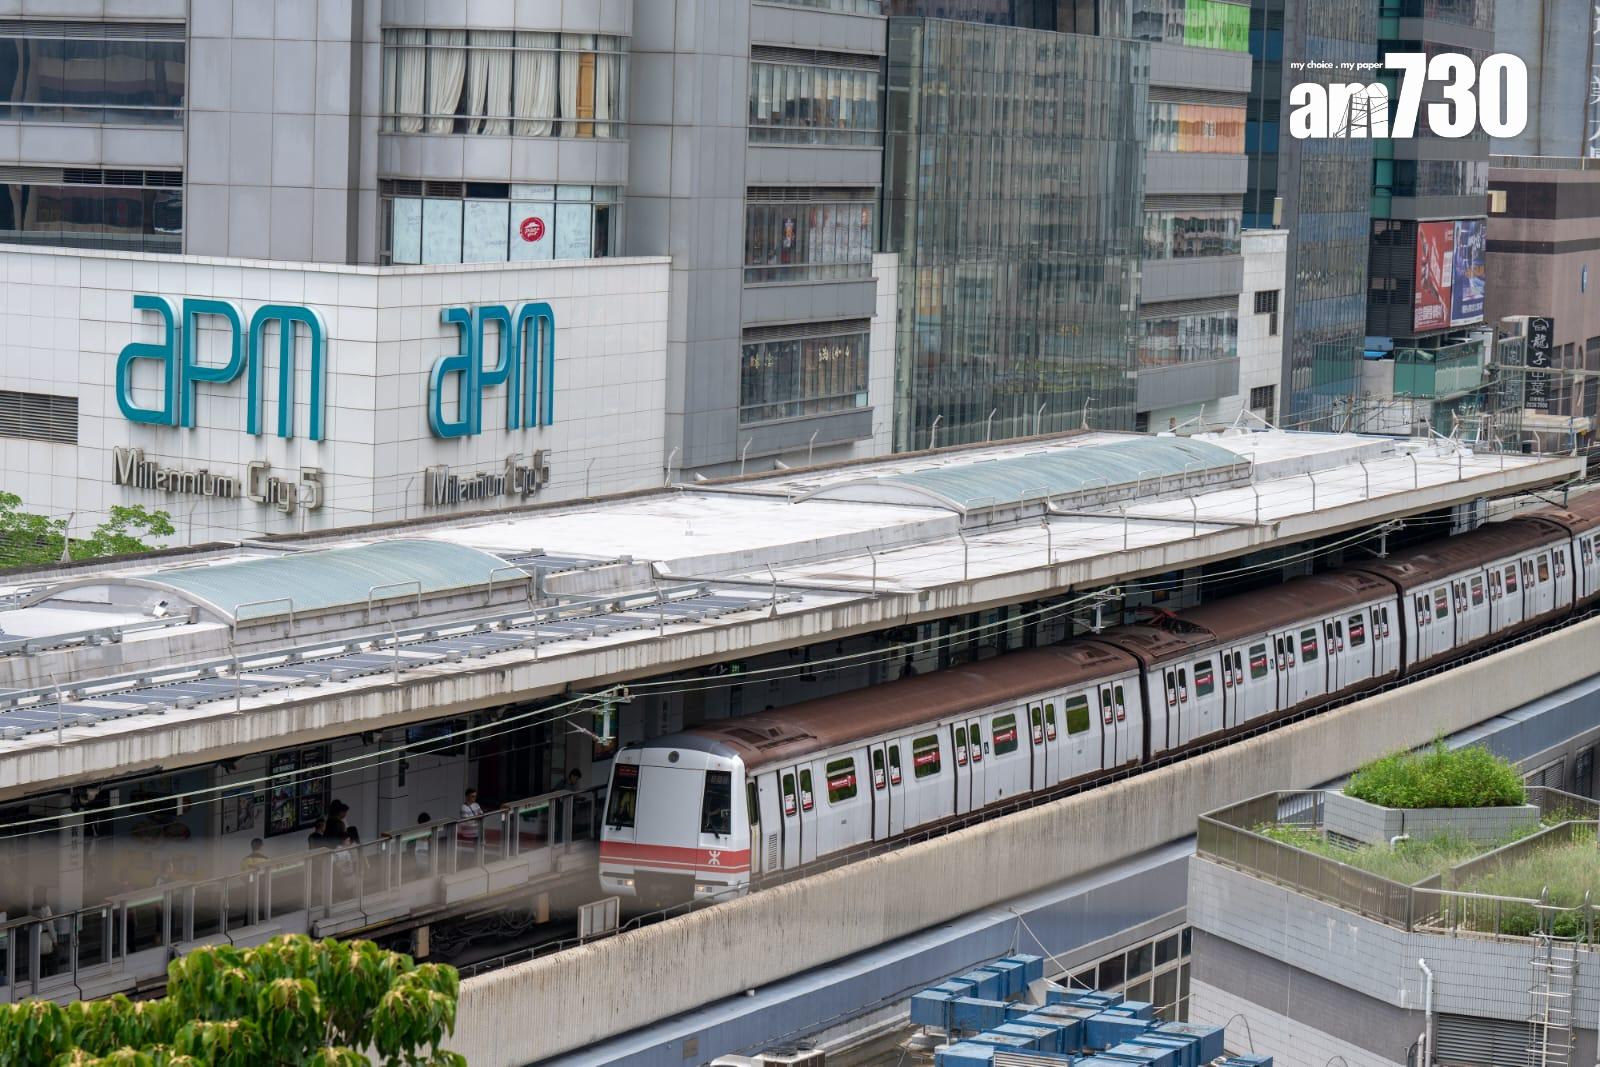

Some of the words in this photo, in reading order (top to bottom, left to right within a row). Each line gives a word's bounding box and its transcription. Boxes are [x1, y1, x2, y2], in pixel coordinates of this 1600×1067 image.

[112, 446, 240, 498] Millennium
[247, 460, 297, 513] City
[299, 466, 325, 510] 5
[425, 464, 507, 507] Millennium
